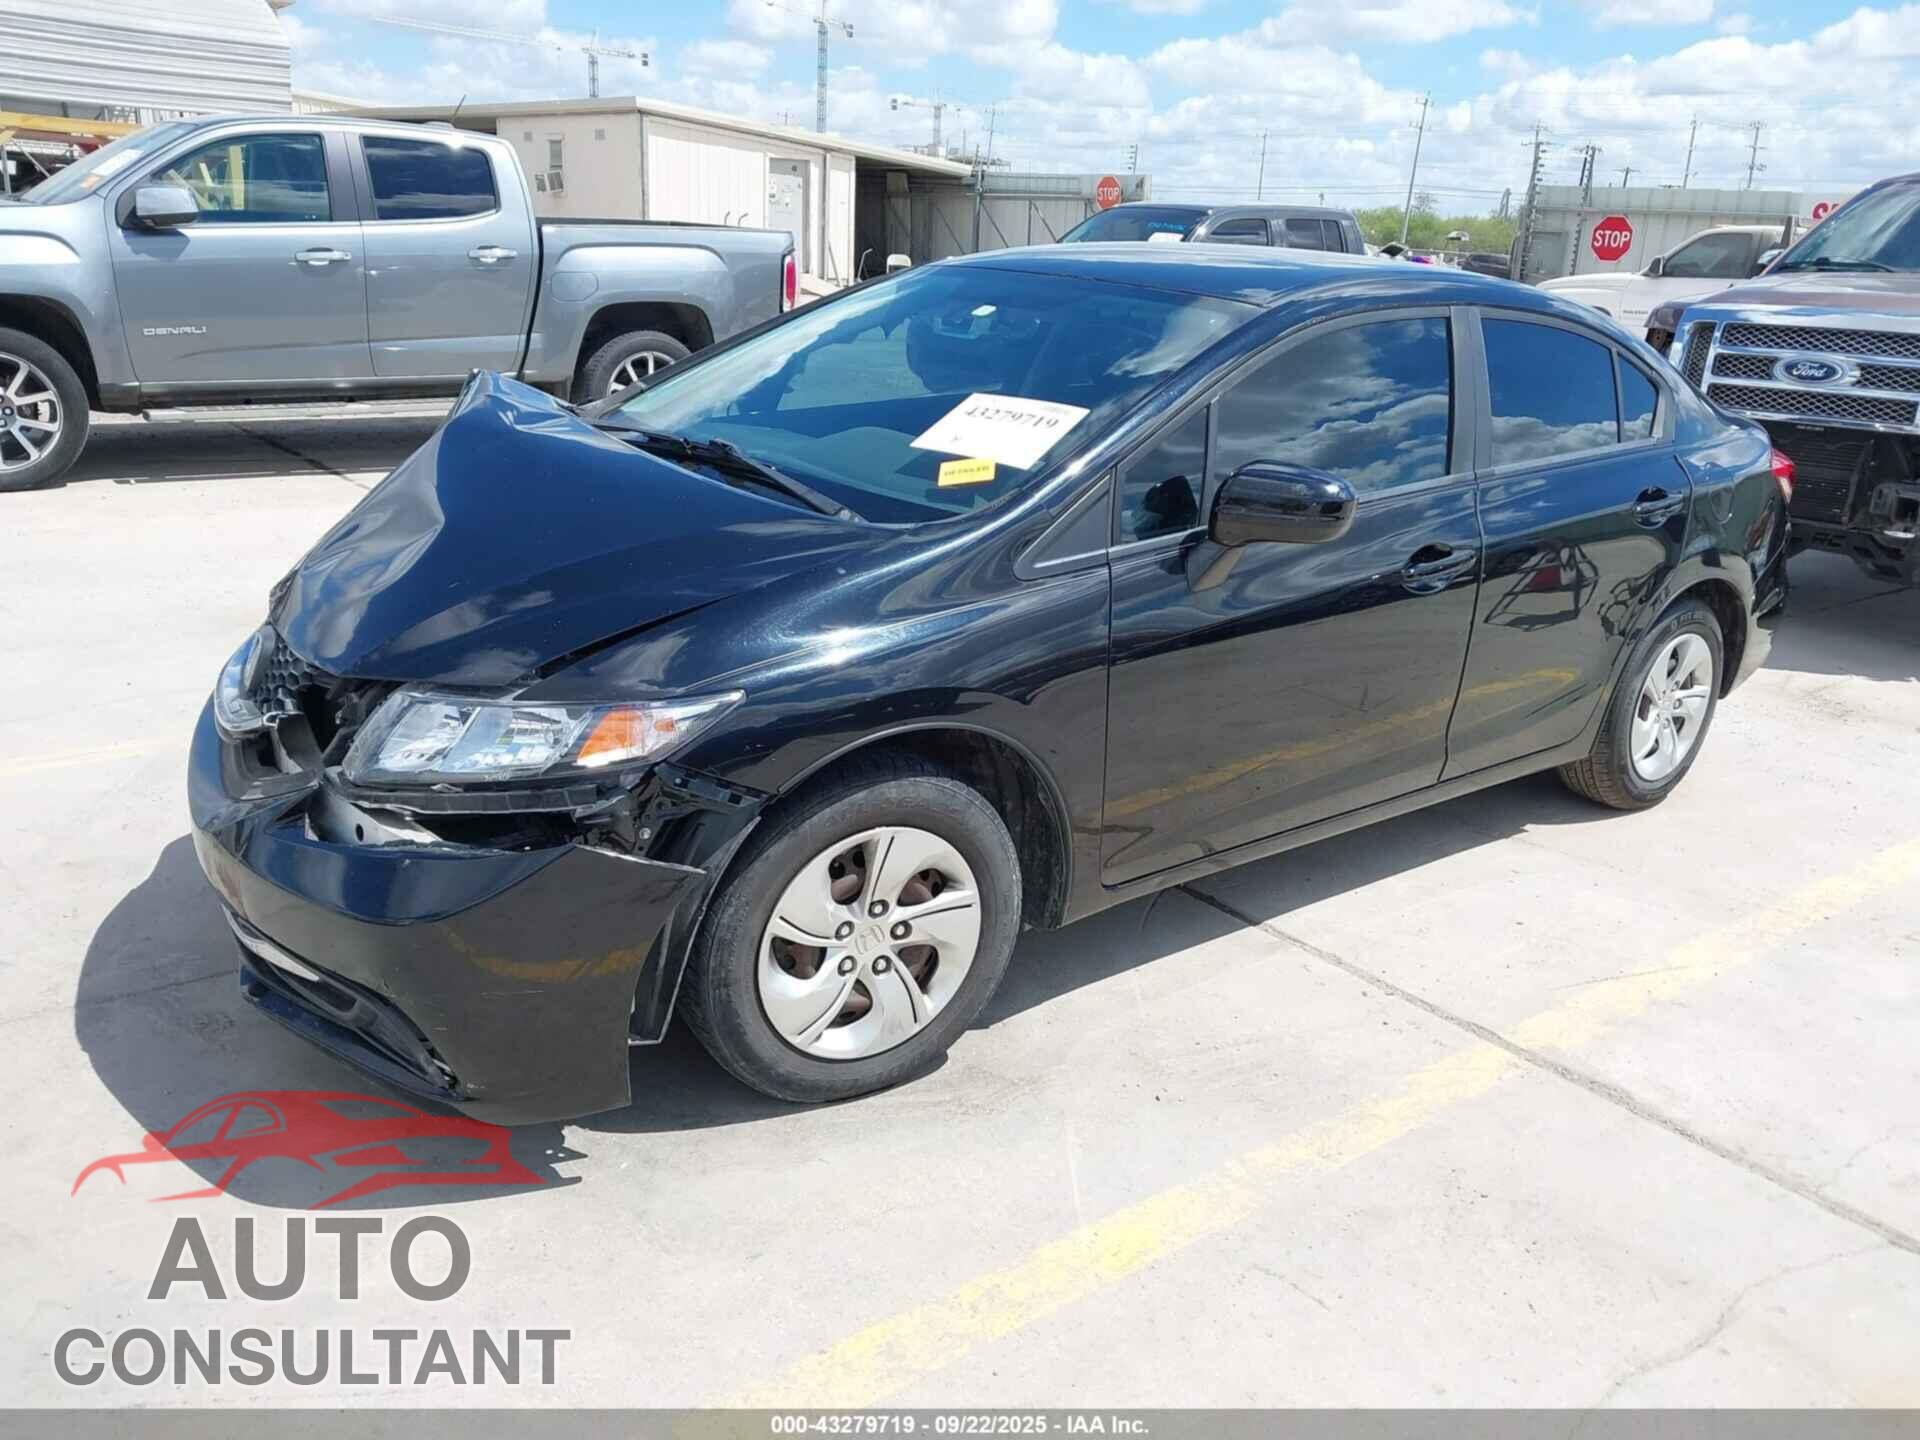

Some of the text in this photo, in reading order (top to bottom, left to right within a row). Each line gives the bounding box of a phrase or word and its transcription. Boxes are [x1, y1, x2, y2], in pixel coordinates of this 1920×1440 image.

[1097, 187, 1120, 201] STOP
[1593, 230, 1631, 248] STOP
[143, 326, 207, 335] DENALI
[1792, 362, 1828, 377] Ford
[965, 407, 1059, 429] 43279719
